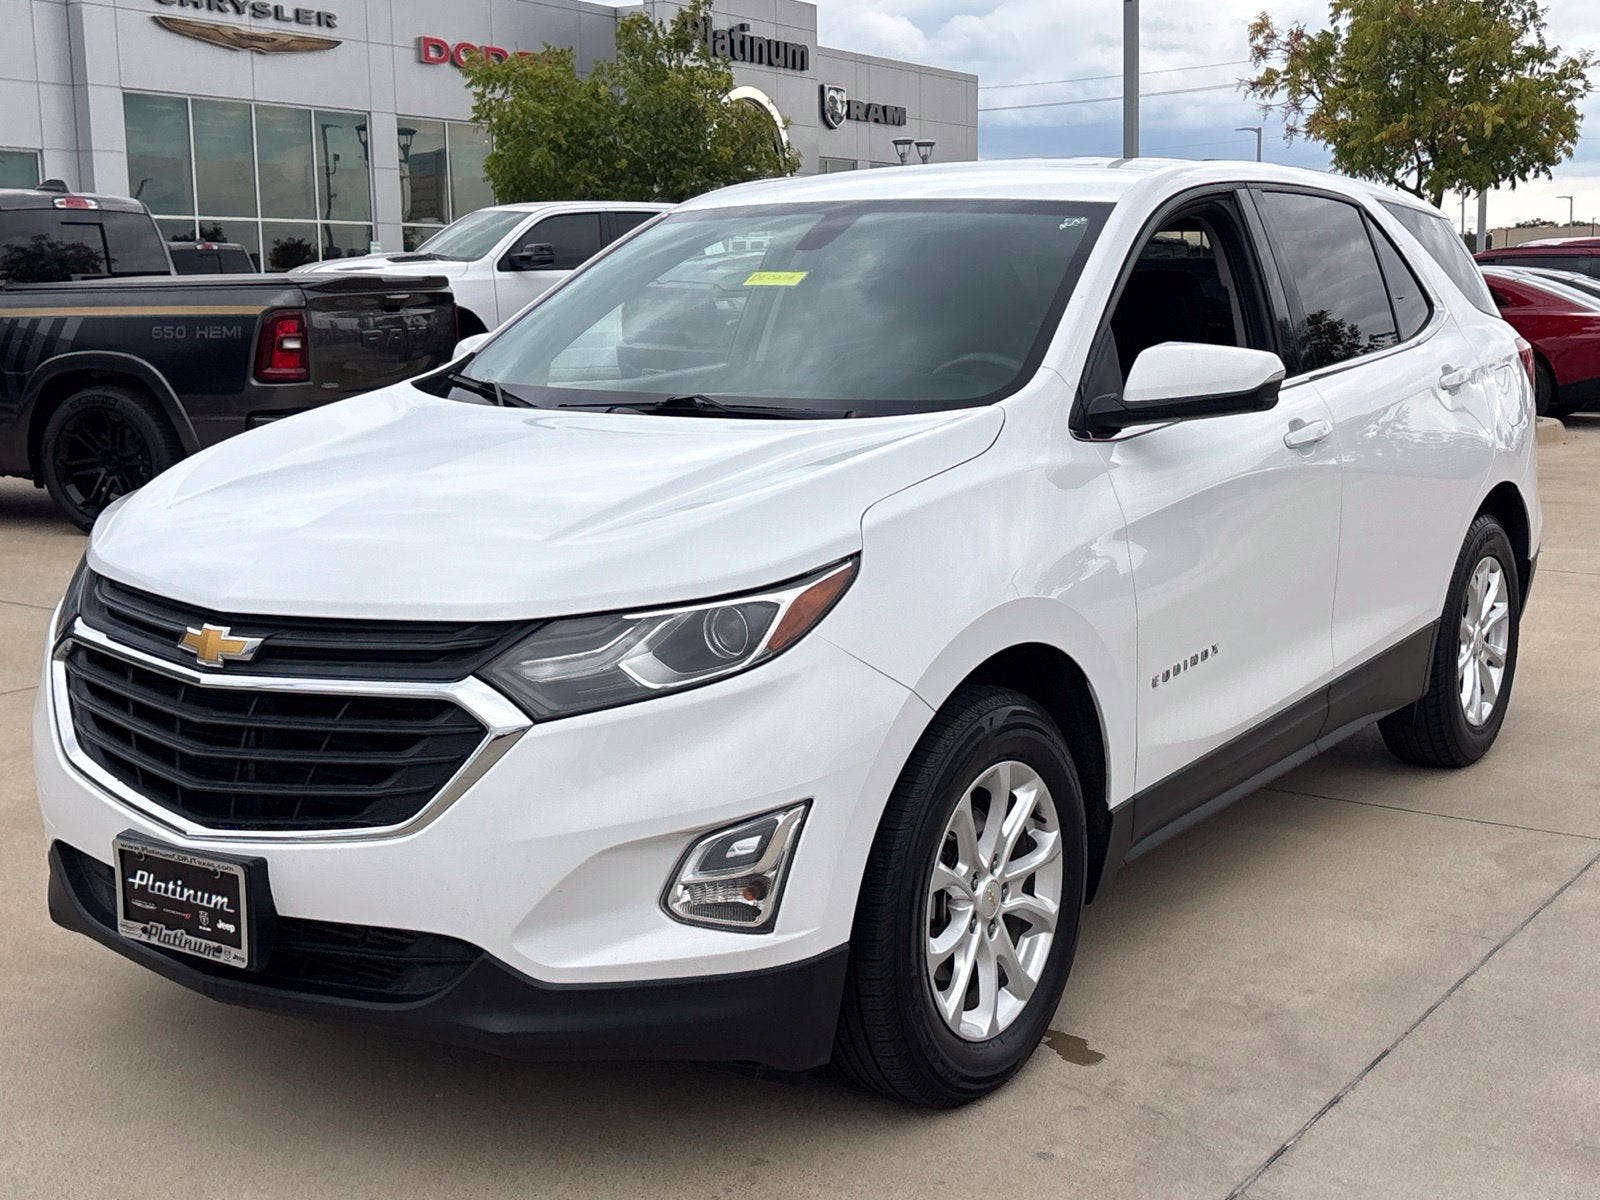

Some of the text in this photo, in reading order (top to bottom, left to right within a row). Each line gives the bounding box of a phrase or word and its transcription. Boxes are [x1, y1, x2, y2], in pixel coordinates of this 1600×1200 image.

[416, 35, 542, 69] DOD
[693, 15, 809, 71] latinum
[848, 99, 907, 126] RAM
[151, 325, 242, 339] 650 HEMI
[361, 327, 428, 347] RAM
[1151, 643, 1220, 689] EQUINOX
[128, 869, 236, 914] Platinum
[148, 923, 222, 959] Platinum
[216, 919, 236, 934] Jeep
